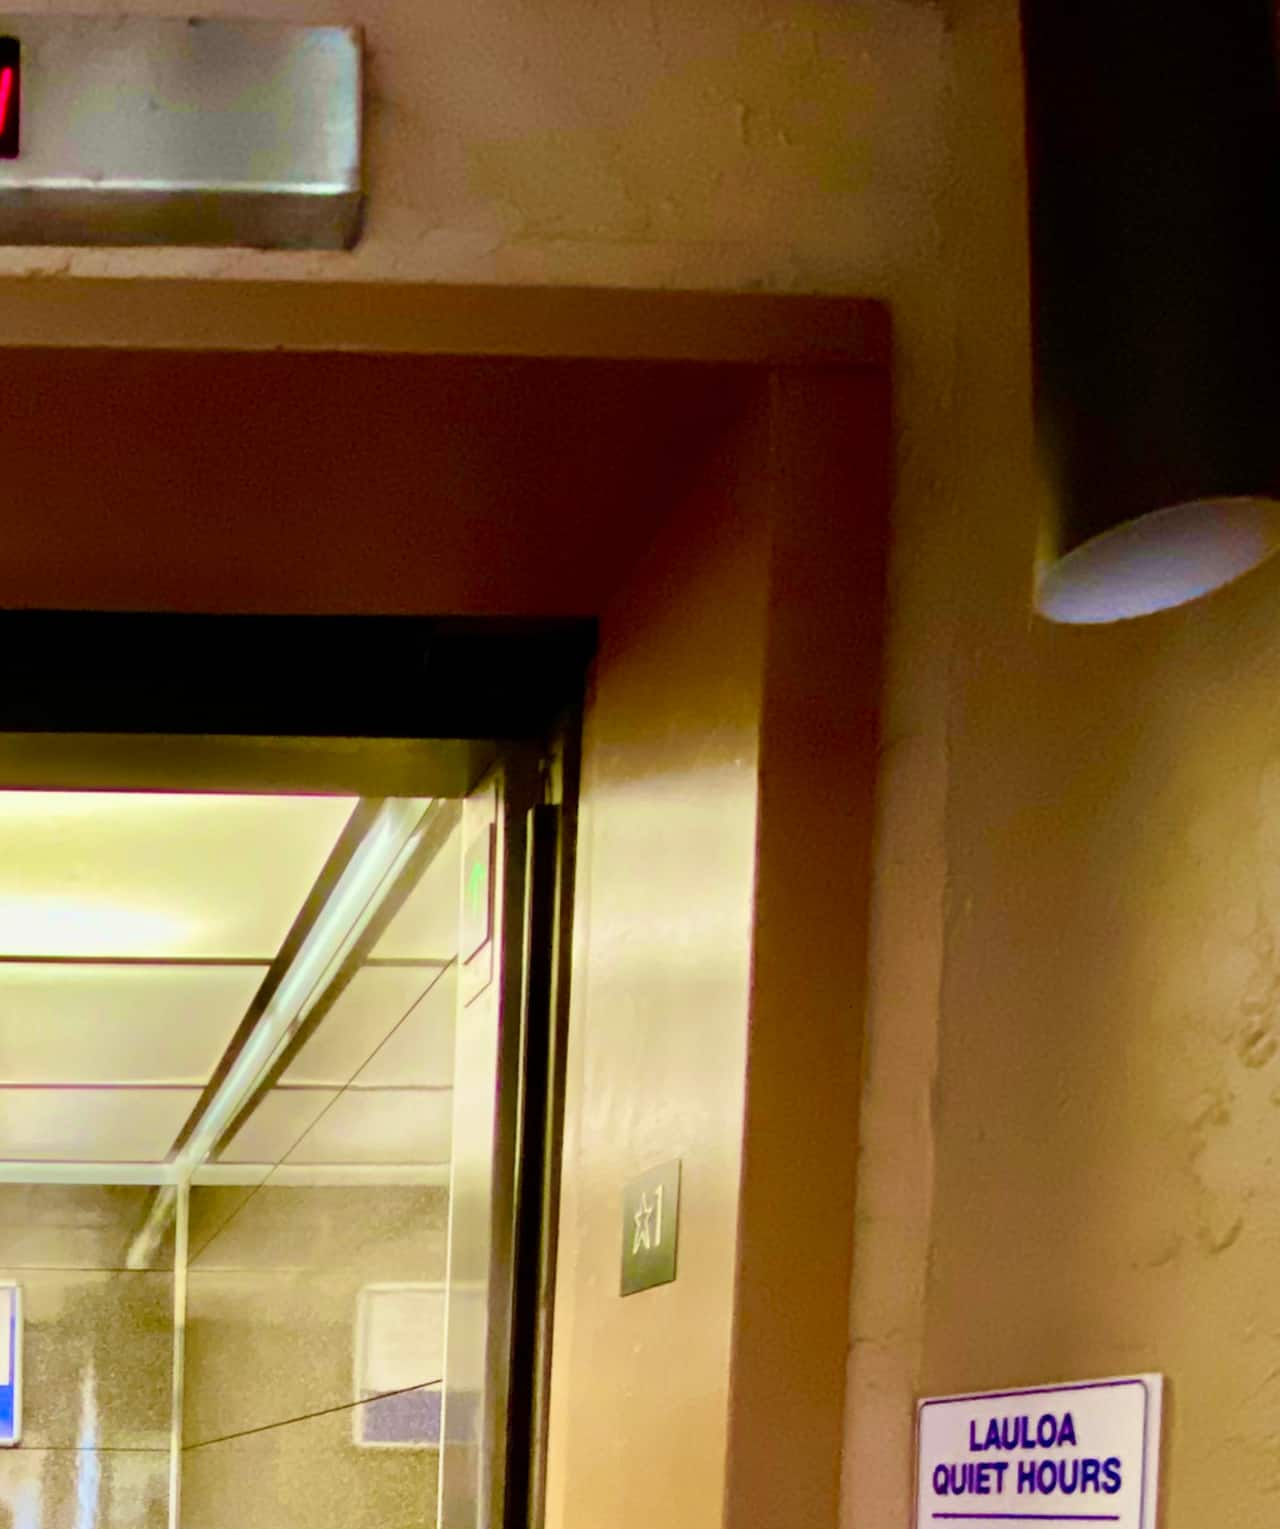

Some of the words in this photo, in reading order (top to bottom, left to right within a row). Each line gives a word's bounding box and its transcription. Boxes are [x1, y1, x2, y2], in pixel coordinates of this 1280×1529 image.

[969, 1412, 1077, 1452] LAULOA
[932, 1462, 1009, 1496] QUIET
[1016, 1457, 1122, 1495] HOURS
